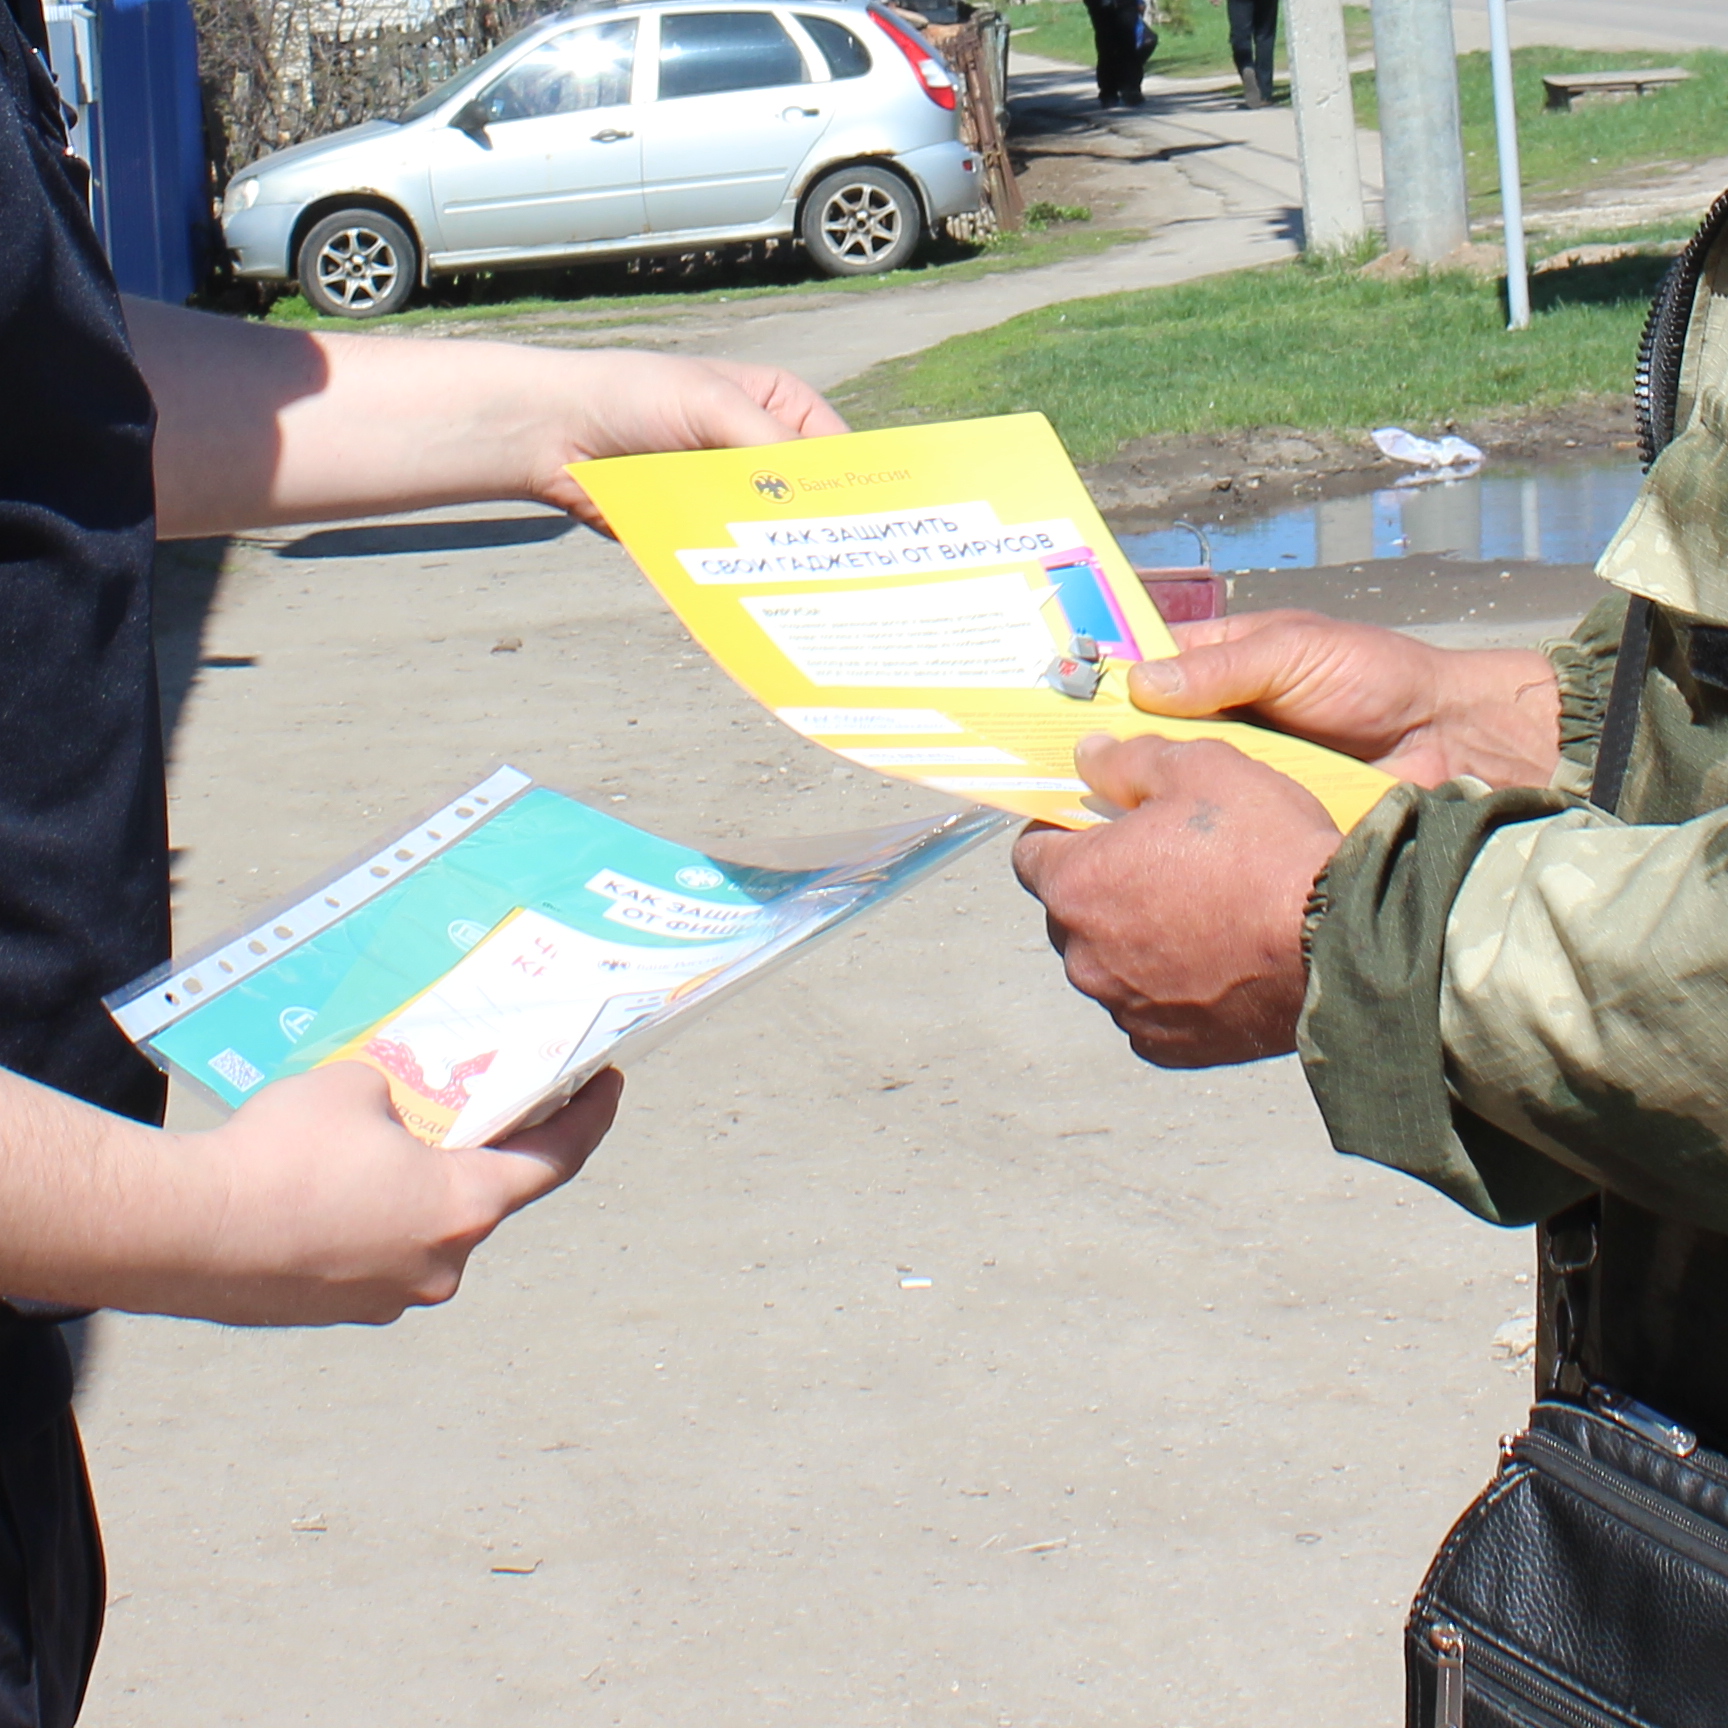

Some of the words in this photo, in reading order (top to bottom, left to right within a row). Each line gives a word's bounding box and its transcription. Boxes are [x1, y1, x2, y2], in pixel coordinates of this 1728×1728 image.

[797, 478, 845, 492] Банк
[844, 469, 912, 487] России
[765, 529, 819, 545] КАК
[821, 517, 959, 543] ЗАЩИТИТЬ
[701, 558, 773, 575] СВОИ
[775, 550, 900, 572] ГАДЖЕТЫ
[902, 545, 933, 563] ОТ
[937, 532, 1055, 560] ВИРУСОВ
[603, 879, 663, 907] КАК
[622, 907, 663, 924] ОТ
